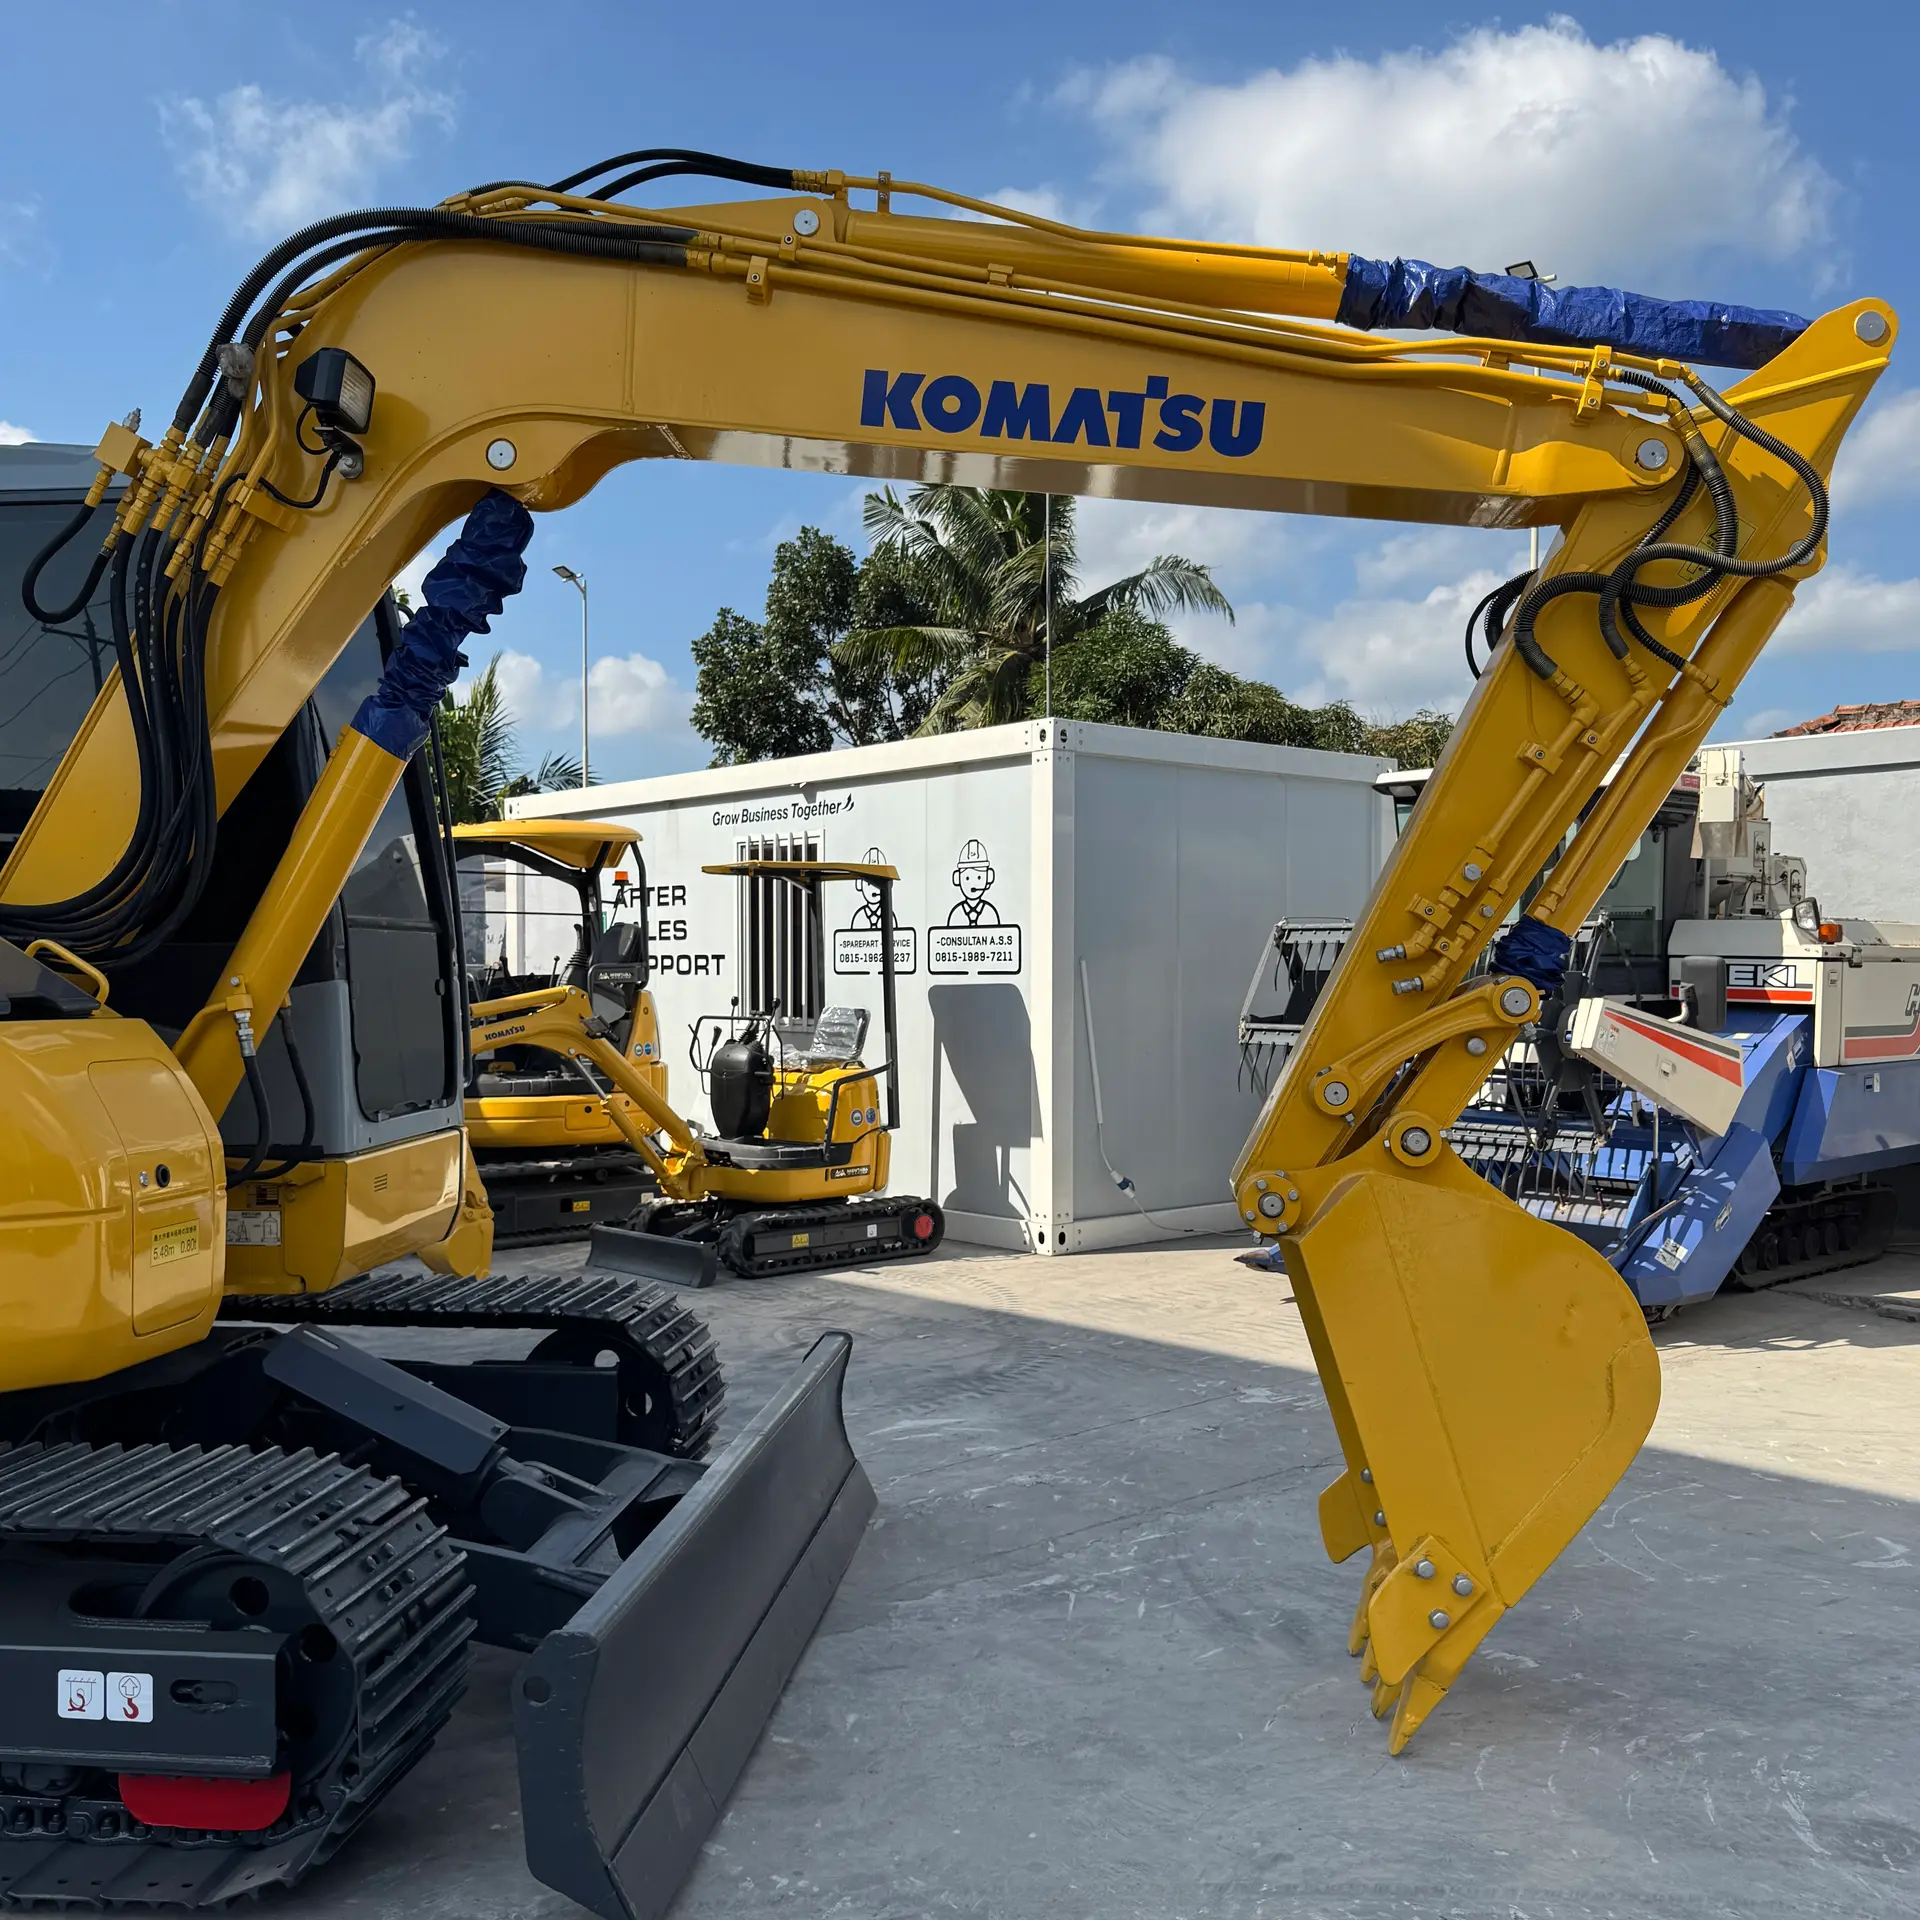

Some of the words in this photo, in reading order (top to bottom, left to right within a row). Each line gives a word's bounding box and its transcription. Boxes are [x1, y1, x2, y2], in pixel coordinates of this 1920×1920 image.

[859, 368, 1266, 458] KOMATSU
[712, 811, 740, 826] Grow
[741, 806, 789, 824] Business
[791, 799, 842, 821] Together
[989, 935, 1013, 946] A.S.S
[648, 954, 726, 976] PPORT
[935, 951, 1013, 962] 0815-1989-7211
[1726, 963, 1797, 988] EKI
[484, 1024, 526, 1041] KOMATSU
